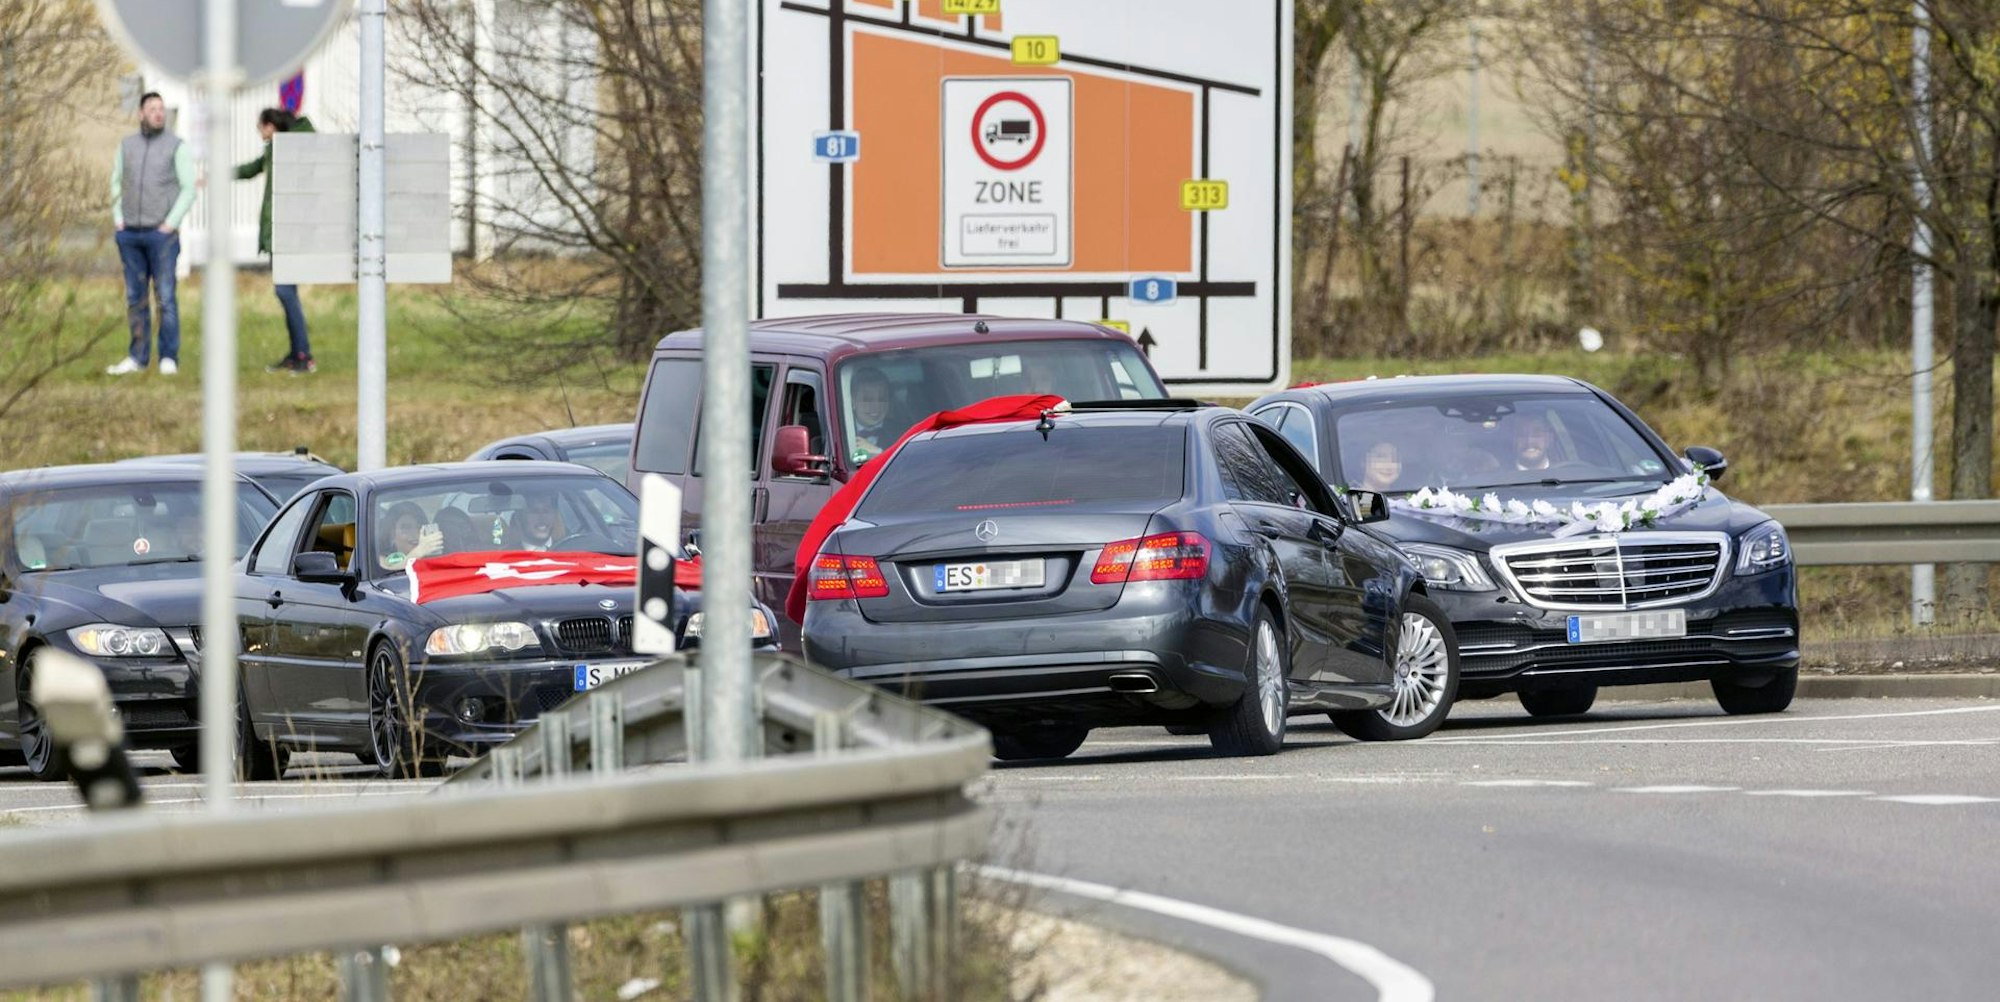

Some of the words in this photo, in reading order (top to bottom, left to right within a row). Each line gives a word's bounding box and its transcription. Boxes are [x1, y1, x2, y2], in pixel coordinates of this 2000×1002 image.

[1026, 41, 1046, 59] 10
[826, 136, 847, 157] 81
[975, 181, 1043, 204] ZONE
[1189, 186, 1221, 204] 313
[966, 222, 1049, 235] Lieferverkehr
[997, 237, 1020, 248] frei
[1145, 280, 1160, 300] 8
[946, 566, 973, 587] ES
